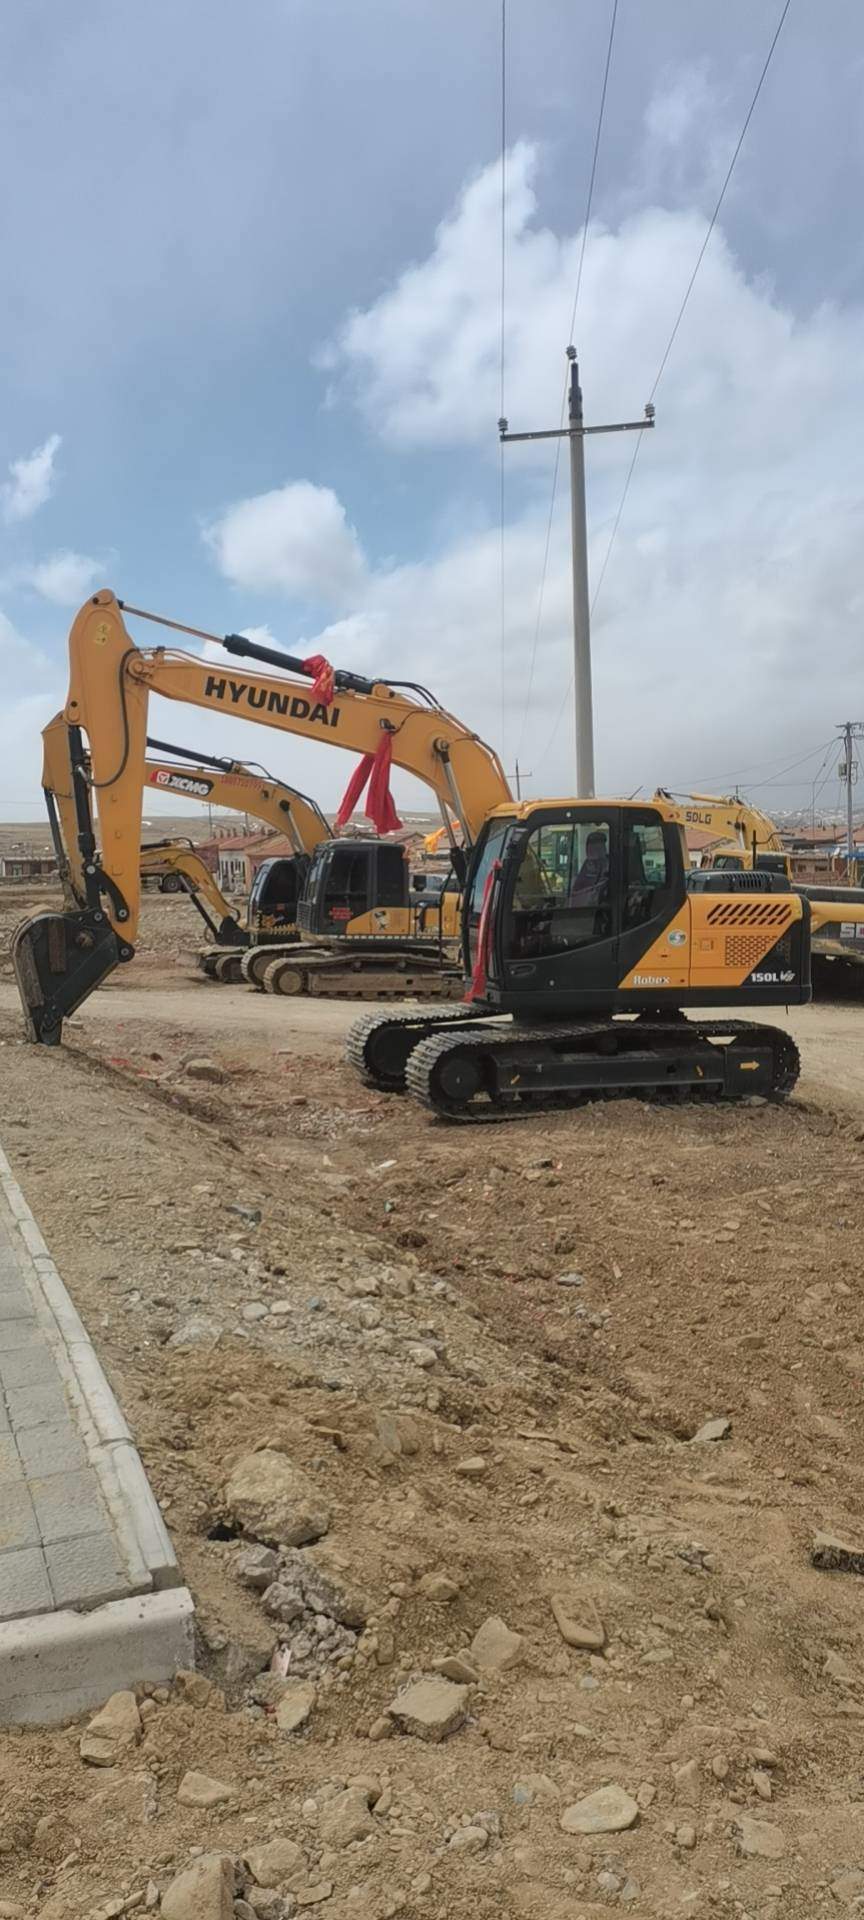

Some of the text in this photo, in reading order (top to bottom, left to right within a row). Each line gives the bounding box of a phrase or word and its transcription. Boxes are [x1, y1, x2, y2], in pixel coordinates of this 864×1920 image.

[205, 676, 339, 727] HYUNDAI
[168, 775, 209, 796] XCMG
[685, 811, 712, 825] SDLG
[633, 975, 671, 985] Robex
